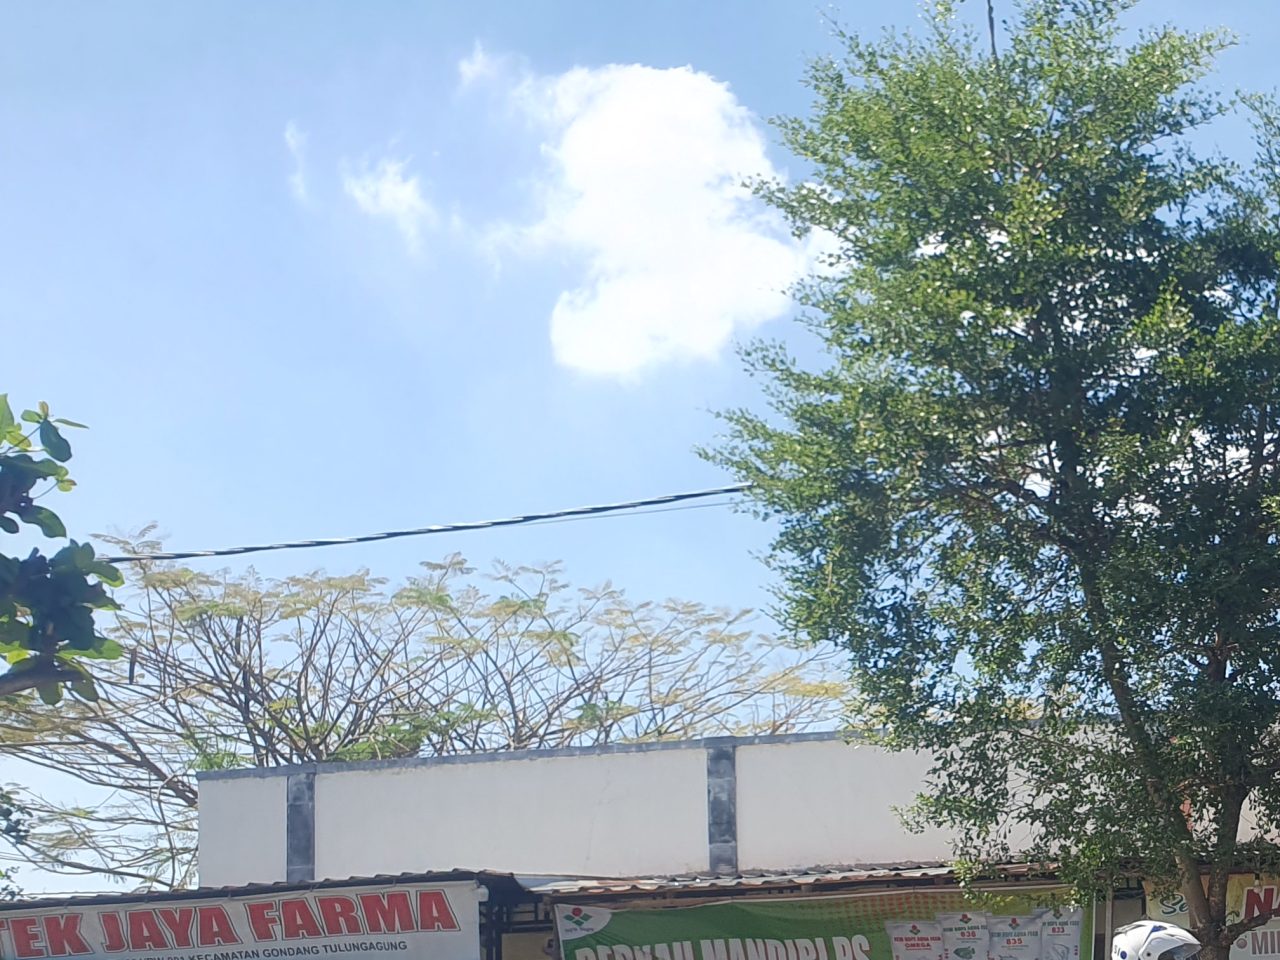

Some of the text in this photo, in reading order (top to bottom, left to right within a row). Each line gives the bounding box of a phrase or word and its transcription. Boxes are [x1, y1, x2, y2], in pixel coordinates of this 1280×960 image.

[0, 889, 461, 960] EK JAYA FARMA
[263, 945, 319, 958] GONDANG
[324, 940, 408, 954] TULUNGAGUNG
